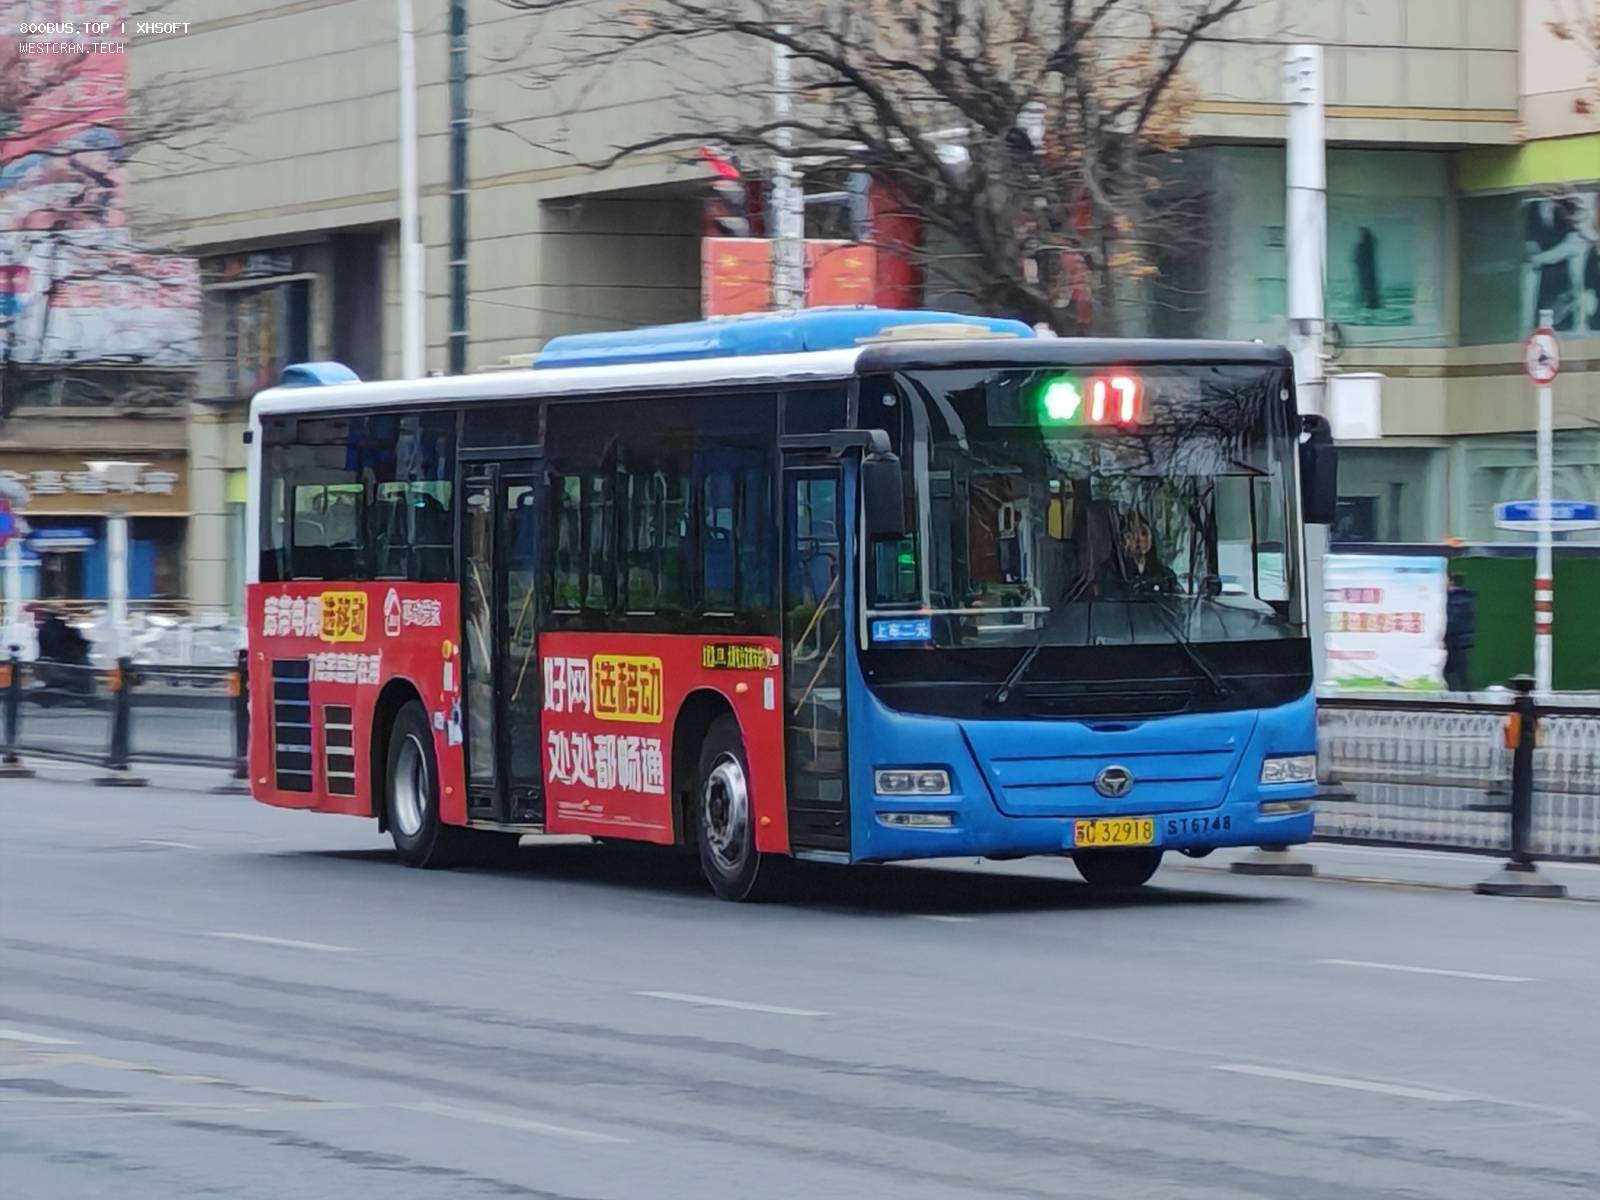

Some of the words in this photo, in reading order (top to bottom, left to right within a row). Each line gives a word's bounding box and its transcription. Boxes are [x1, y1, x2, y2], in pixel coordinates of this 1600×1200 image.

[1090, 375, 1137, 424] 17
[874, 622, 930, 639] 上车二元
[543, 656, 661, 718] 好网选移动
[547, 729, 666, 795] 处处都畅通
[1167, 815, 1232, 836] ST6748
